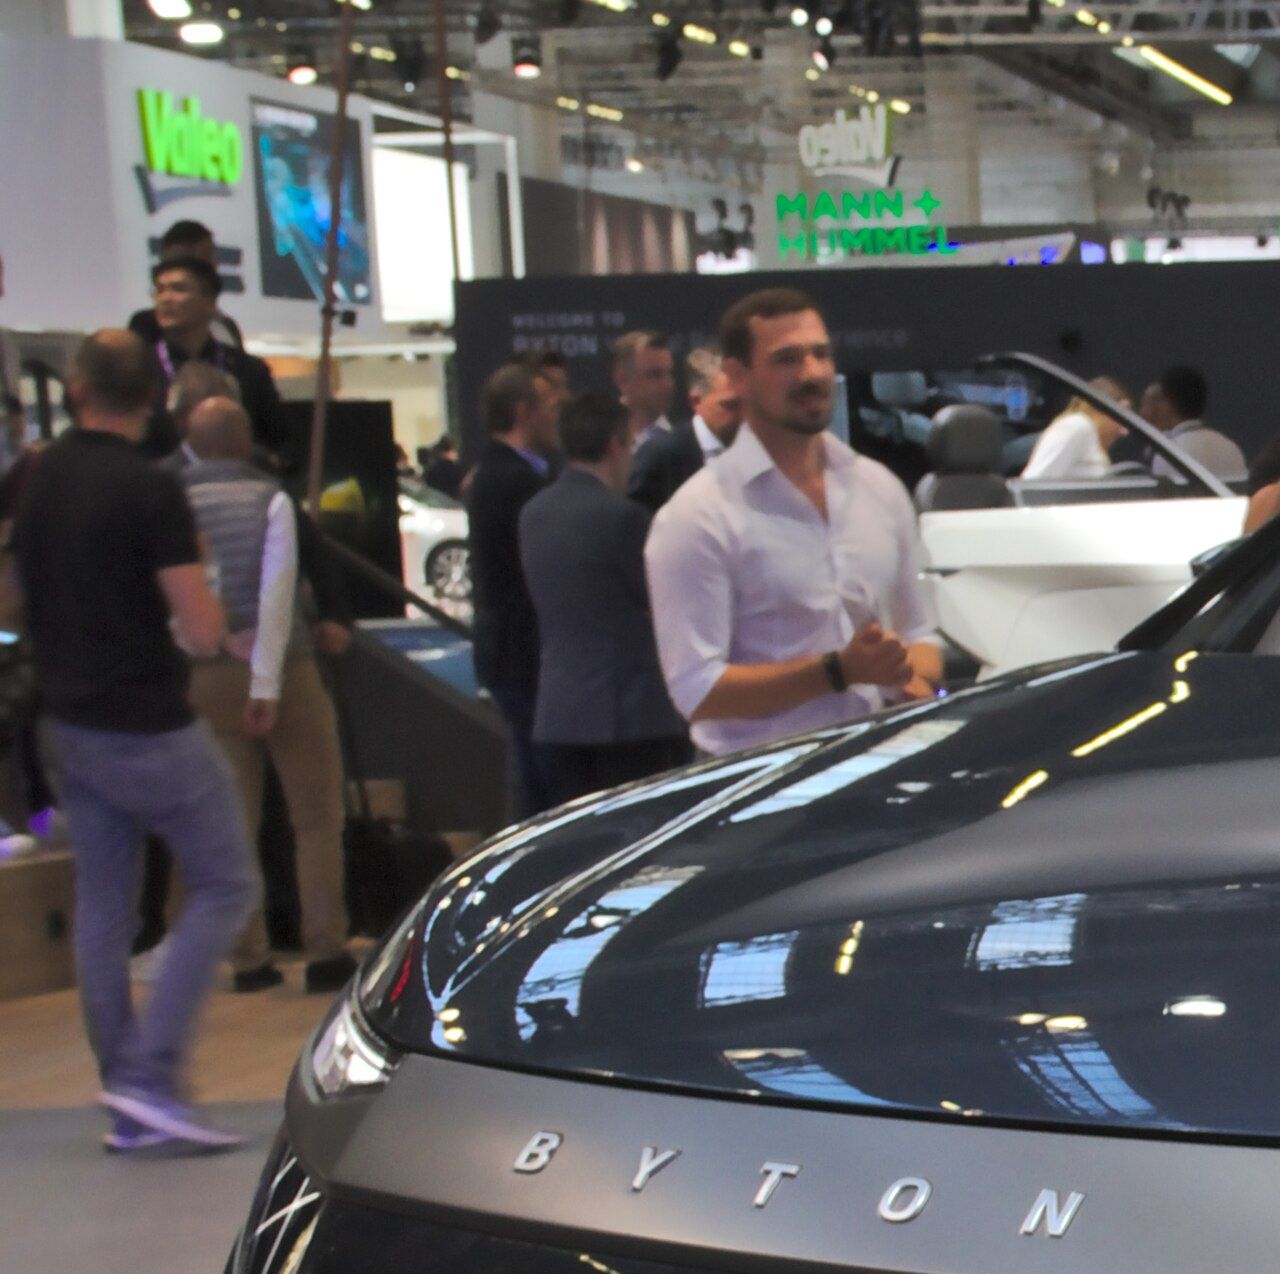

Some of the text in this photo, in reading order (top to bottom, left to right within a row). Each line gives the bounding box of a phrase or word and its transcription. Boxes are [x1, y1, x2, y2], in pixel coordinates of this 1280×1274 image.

[136, 89, 243, 185] Valeo
[778, 225, 956, 260] HUMMEL
[513, 1131, 1086, 1237] BYTON
